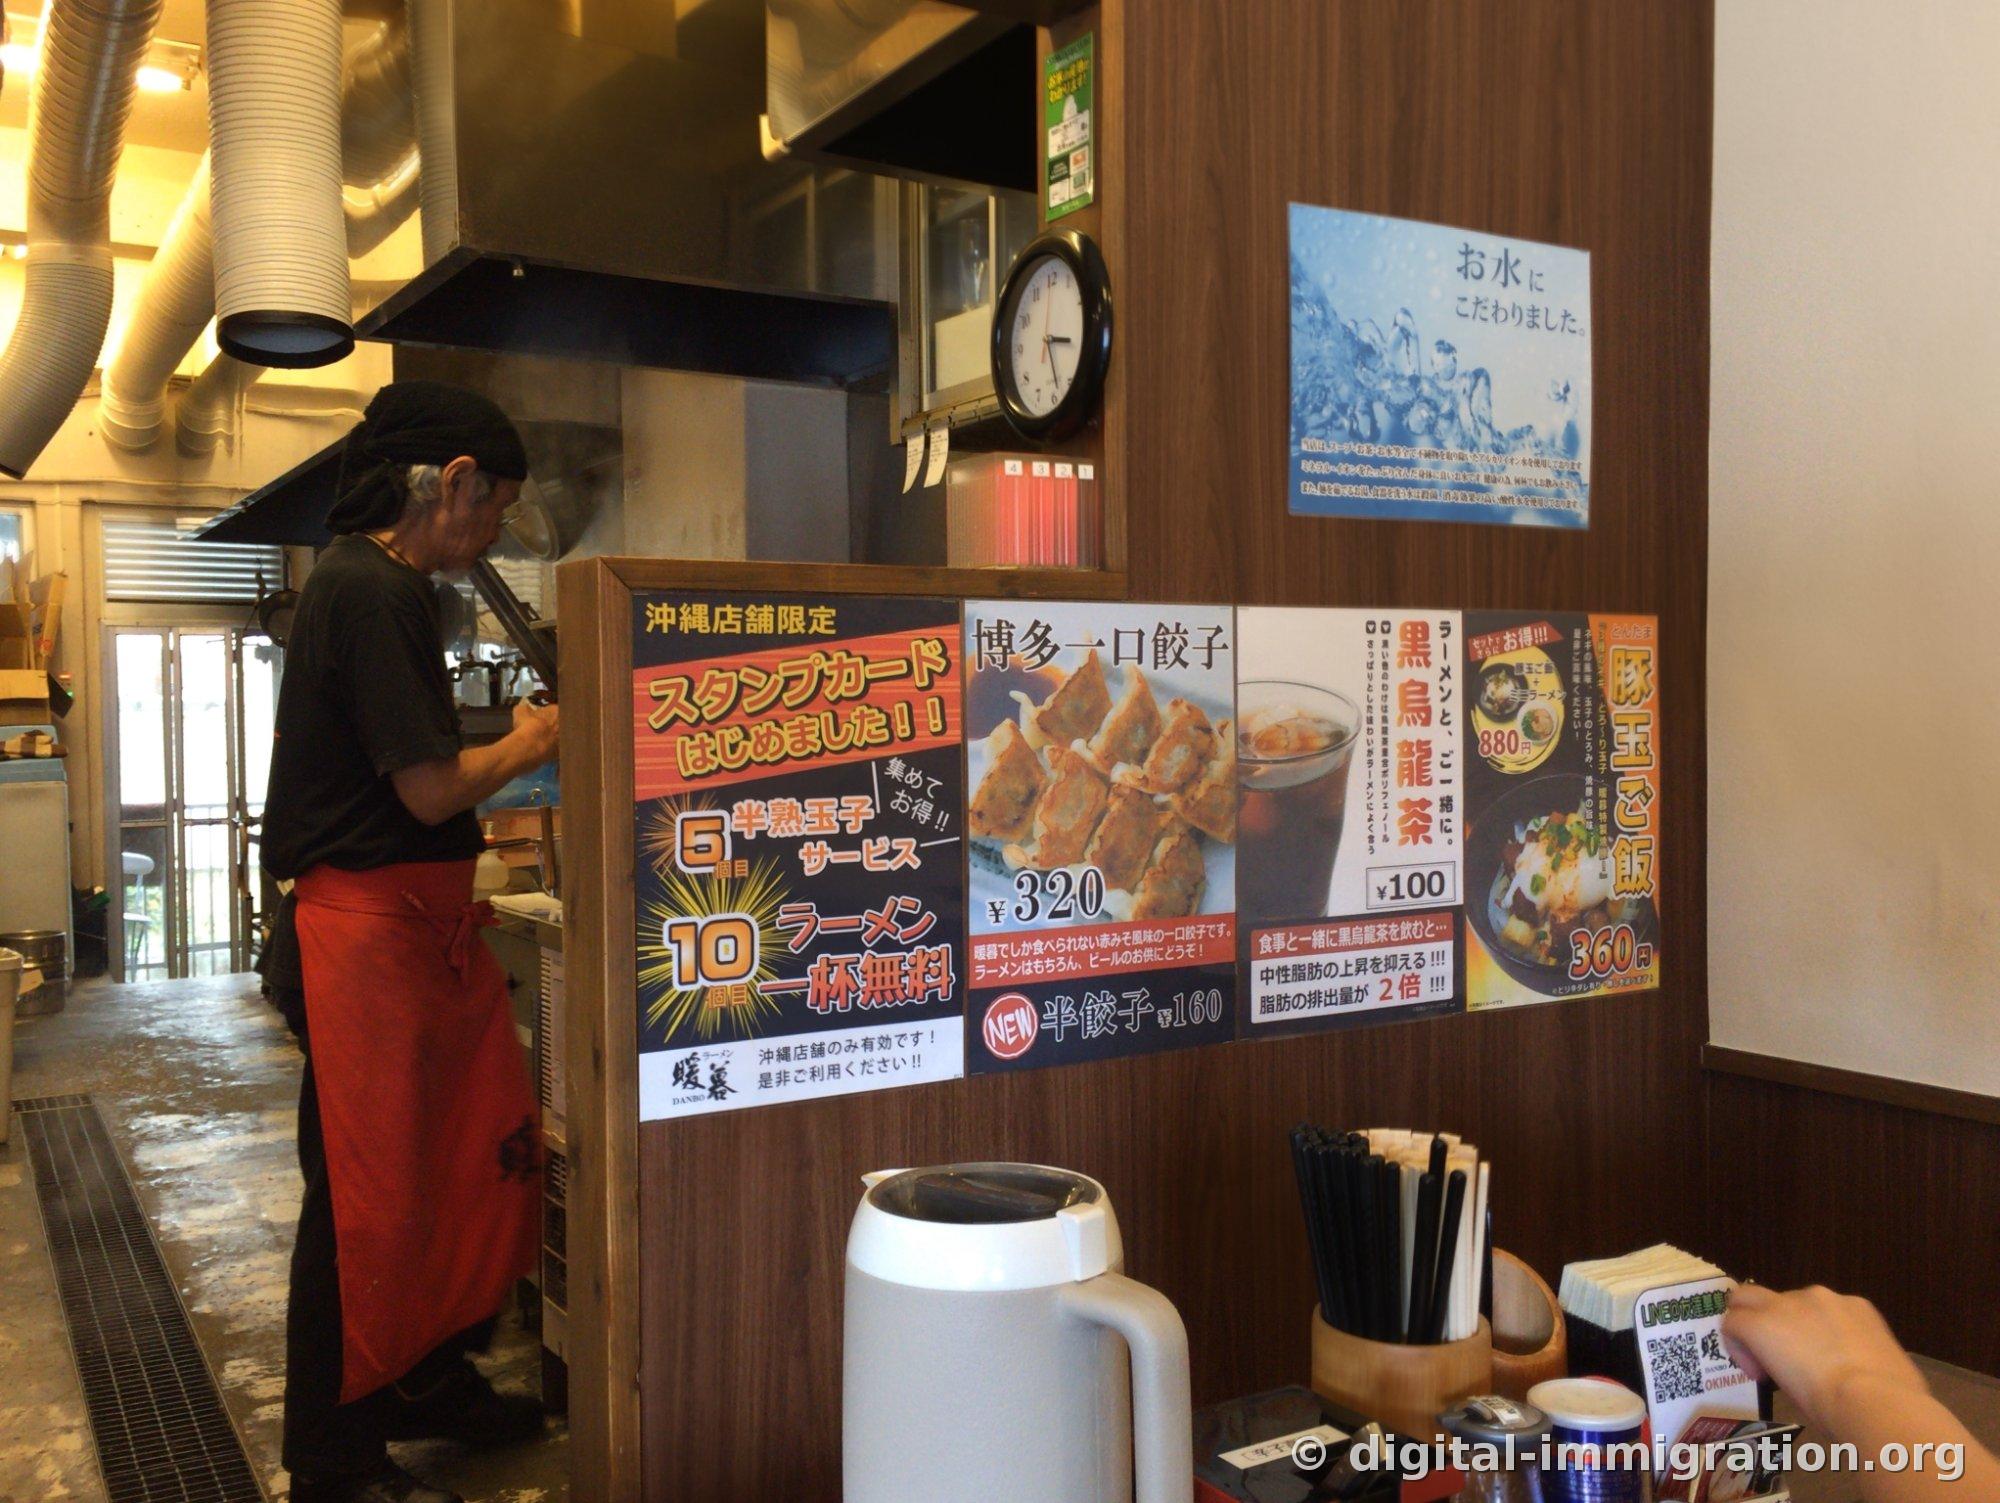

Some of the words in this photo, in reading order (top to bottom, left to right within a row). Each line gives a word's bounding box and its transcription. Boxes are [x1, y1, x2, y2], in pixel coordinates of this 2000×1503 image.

[1457, 242, 1545, 292] お水に
[1456, 296, 1586, 338] こだわりました。
[646, 602, 837, 635] 沖縄店舗限定
[971, 618, 1229, 671] 博多一口餃子
[648, 638, 949, 730] スタンプカード
[1509, 689, 1567, 704] ミニラーメン
[1397, 620, 1433, 846] 黒烏龍茶
[884, 757, 942, 800] 集めて
[1610, 645, 1656, 899] 豚玉ご飯
[732, 795, 875, 839] 半熟玉子
[799, 836, 921, 876] サービス
[776, 896, 937, 952] ラーメン
[1569, 924, 1653, 980] 360円
[758, 944, 955, 1014] 一杯無料
[986, 1006, 1032, 1048] NEW
[1040, 988, 1154, 1042] 半餃子
[701, 1048, 735, 1061] ラーメン
[672, 1094, 705, 1106] DANBO
